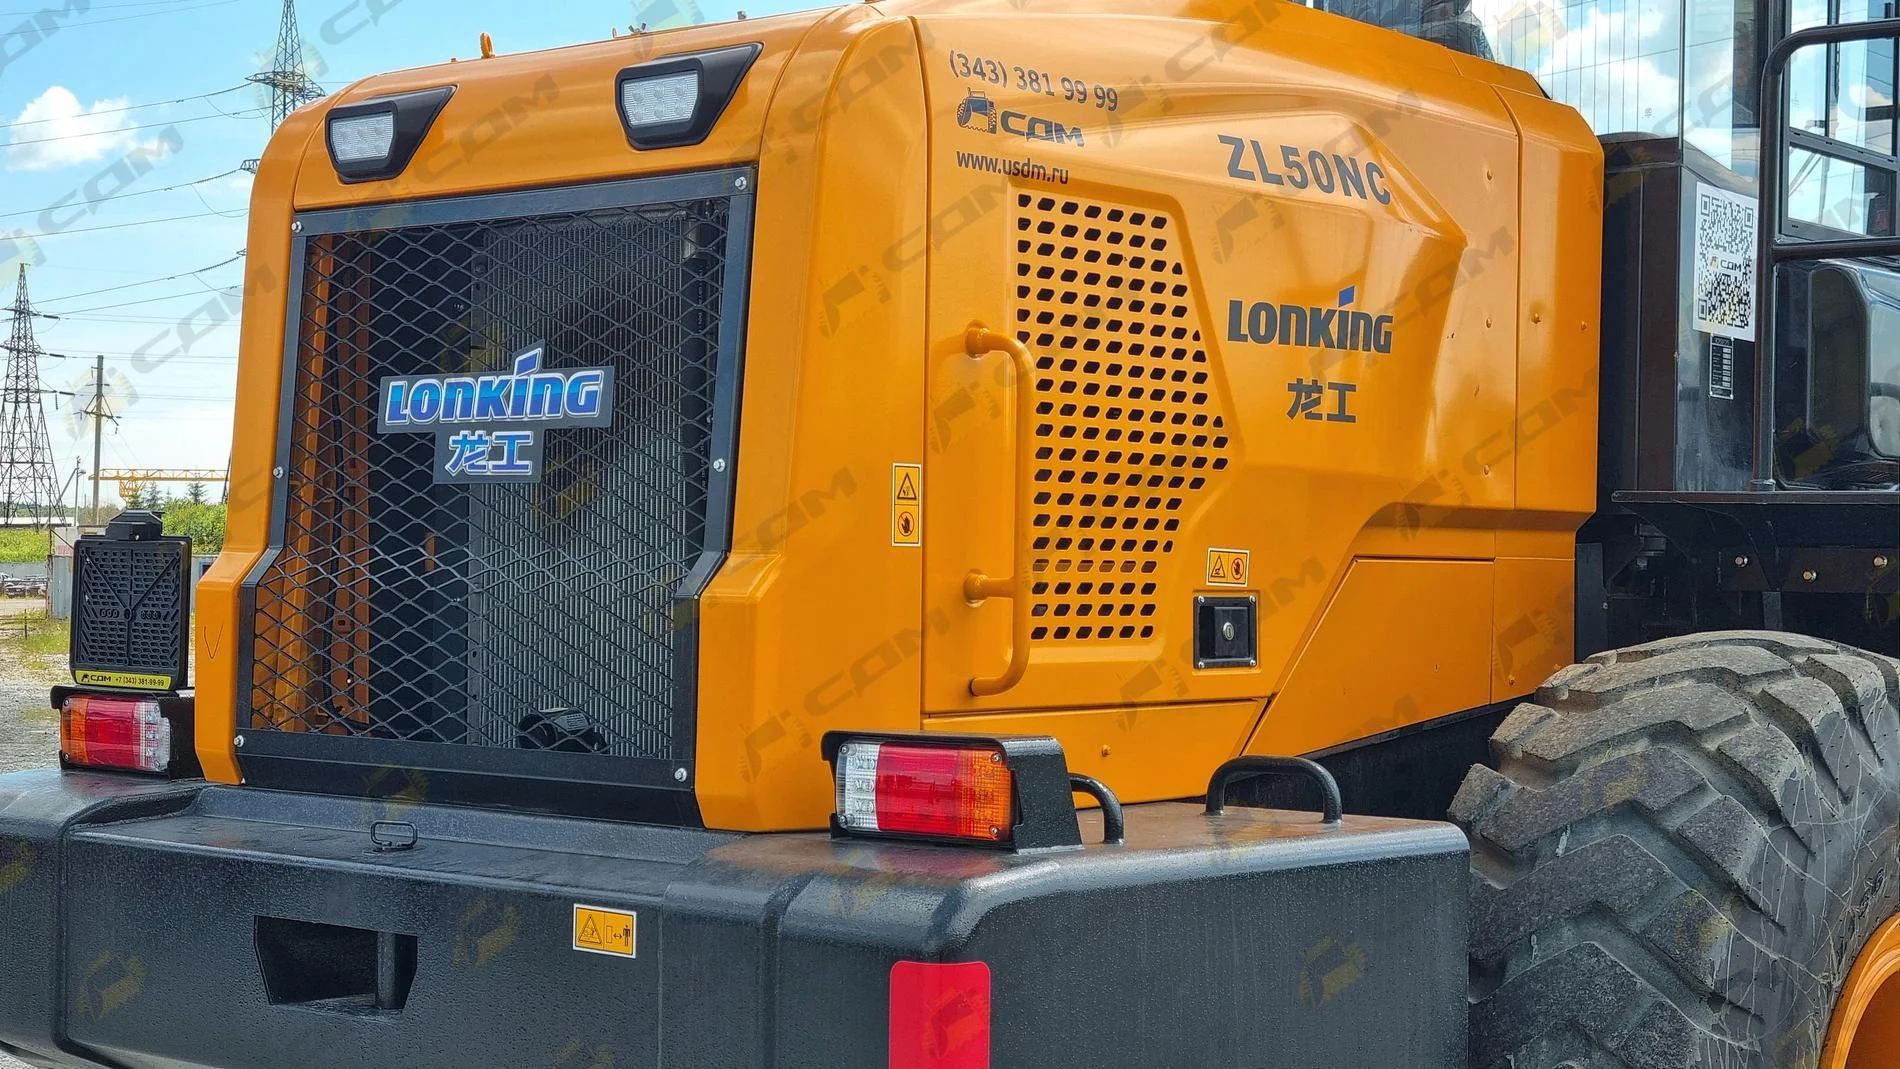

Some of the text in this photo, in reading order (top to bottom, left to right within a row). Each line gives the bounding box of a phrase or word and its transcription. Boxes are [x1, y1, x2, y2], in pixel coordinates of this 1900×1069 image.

[949, 50, 1118, 112] (343) 381 99 99
[956, 150, 1069, 186] www.usdm.ru
[1217, 134, 1391, 206] ZL50NC
[1286, 377, 1357, 424] 龙工
[445, 430, 534, 477] 龙工
[123, 676, 137, 685] (343)
